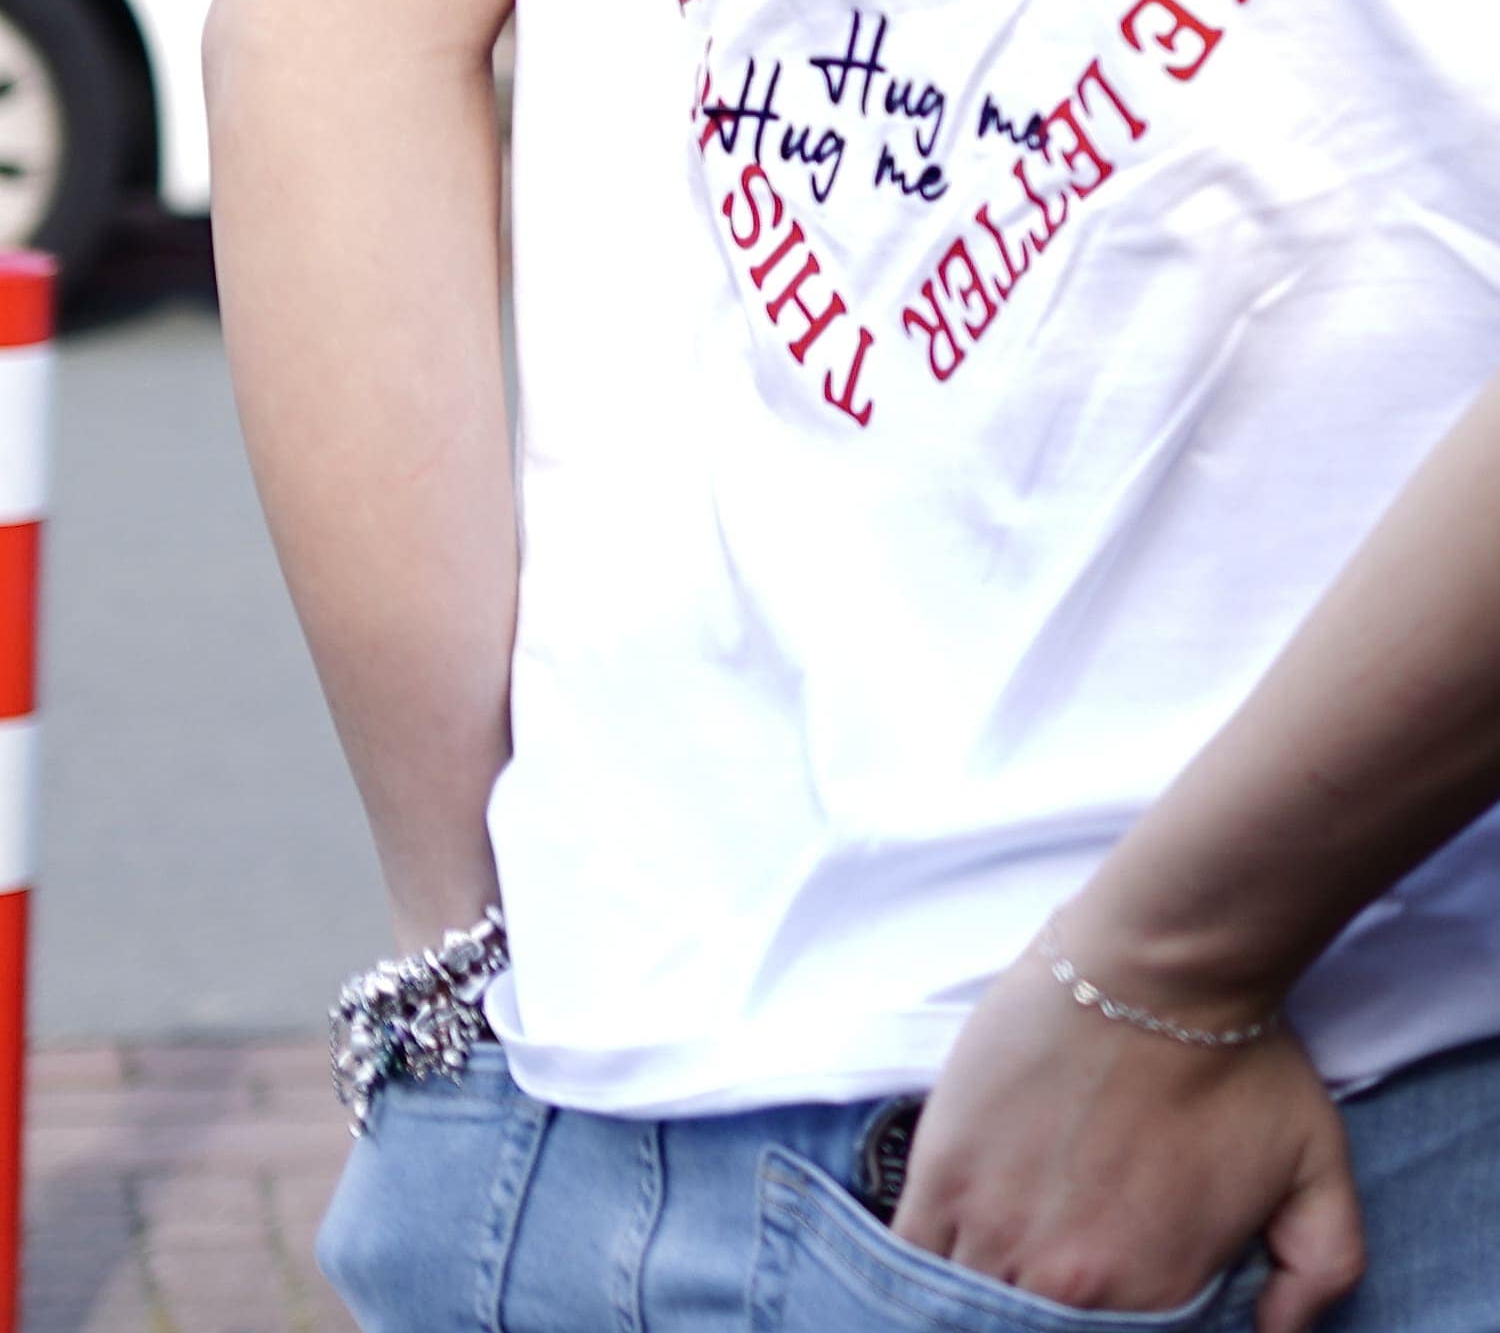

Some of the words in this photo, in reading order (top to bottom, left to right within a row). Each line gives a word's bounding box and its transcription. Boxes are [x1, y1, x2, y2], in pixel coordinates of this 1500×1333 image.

[702, 56, 846, 205] Hug
[874, 141, 951, 203] me
[810, 6, 946, 158] Hug
[723, 161, 877, 429] THIS
[902, 56, 1149, 383] LETTER
